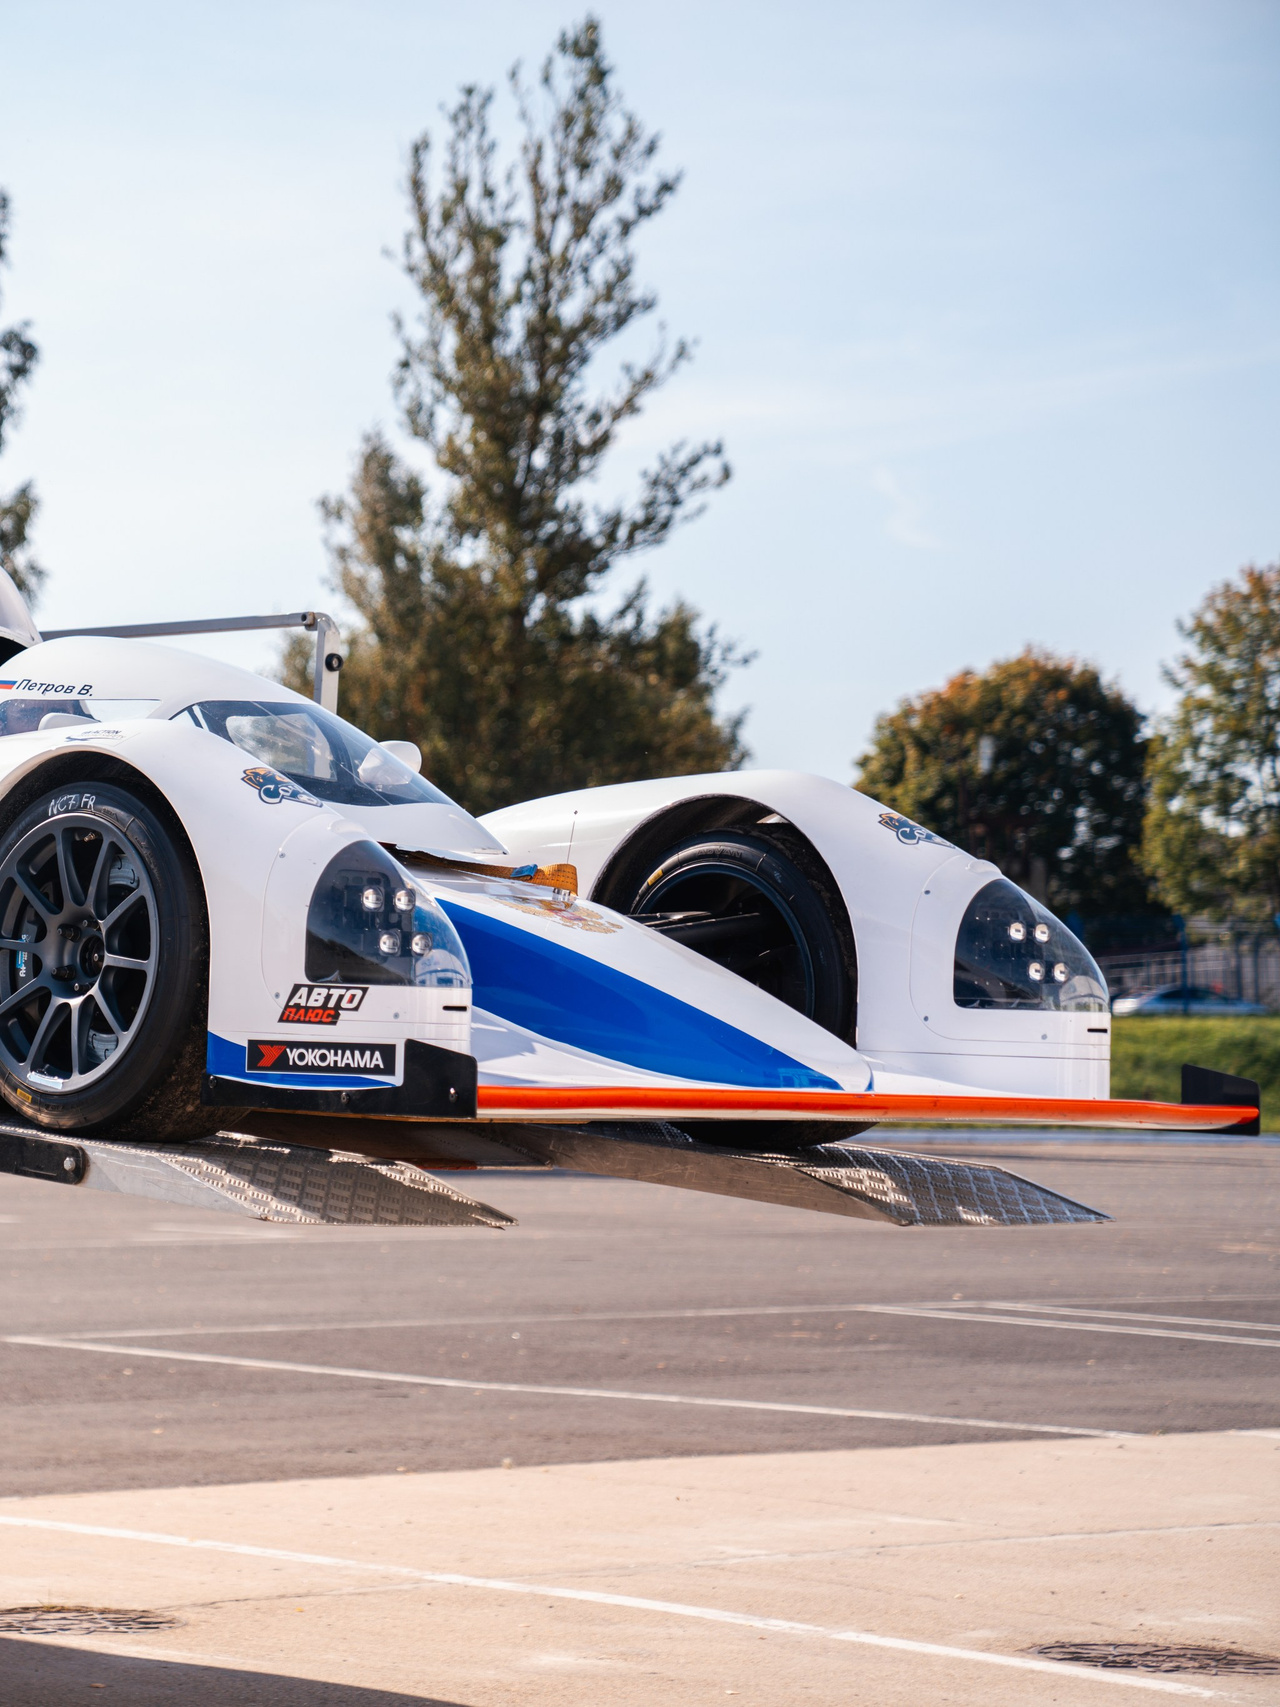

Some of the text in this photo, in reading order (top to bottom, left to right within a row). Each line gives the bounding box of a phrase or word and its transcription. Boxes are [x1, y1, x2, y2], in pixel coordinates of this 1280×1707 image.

[16, 678, 94, 697] Петров В.
[48, 793, 80, 817] NC7
[81, 793, 96, 812] FR
[697, 848, 742, 858] ADVAN
[288, 987, 364, 1009] АВТО
[282, 1007, 335, 1023] ПЛЮС
[286, 1048, 385, 1069] YOKOHAMA
